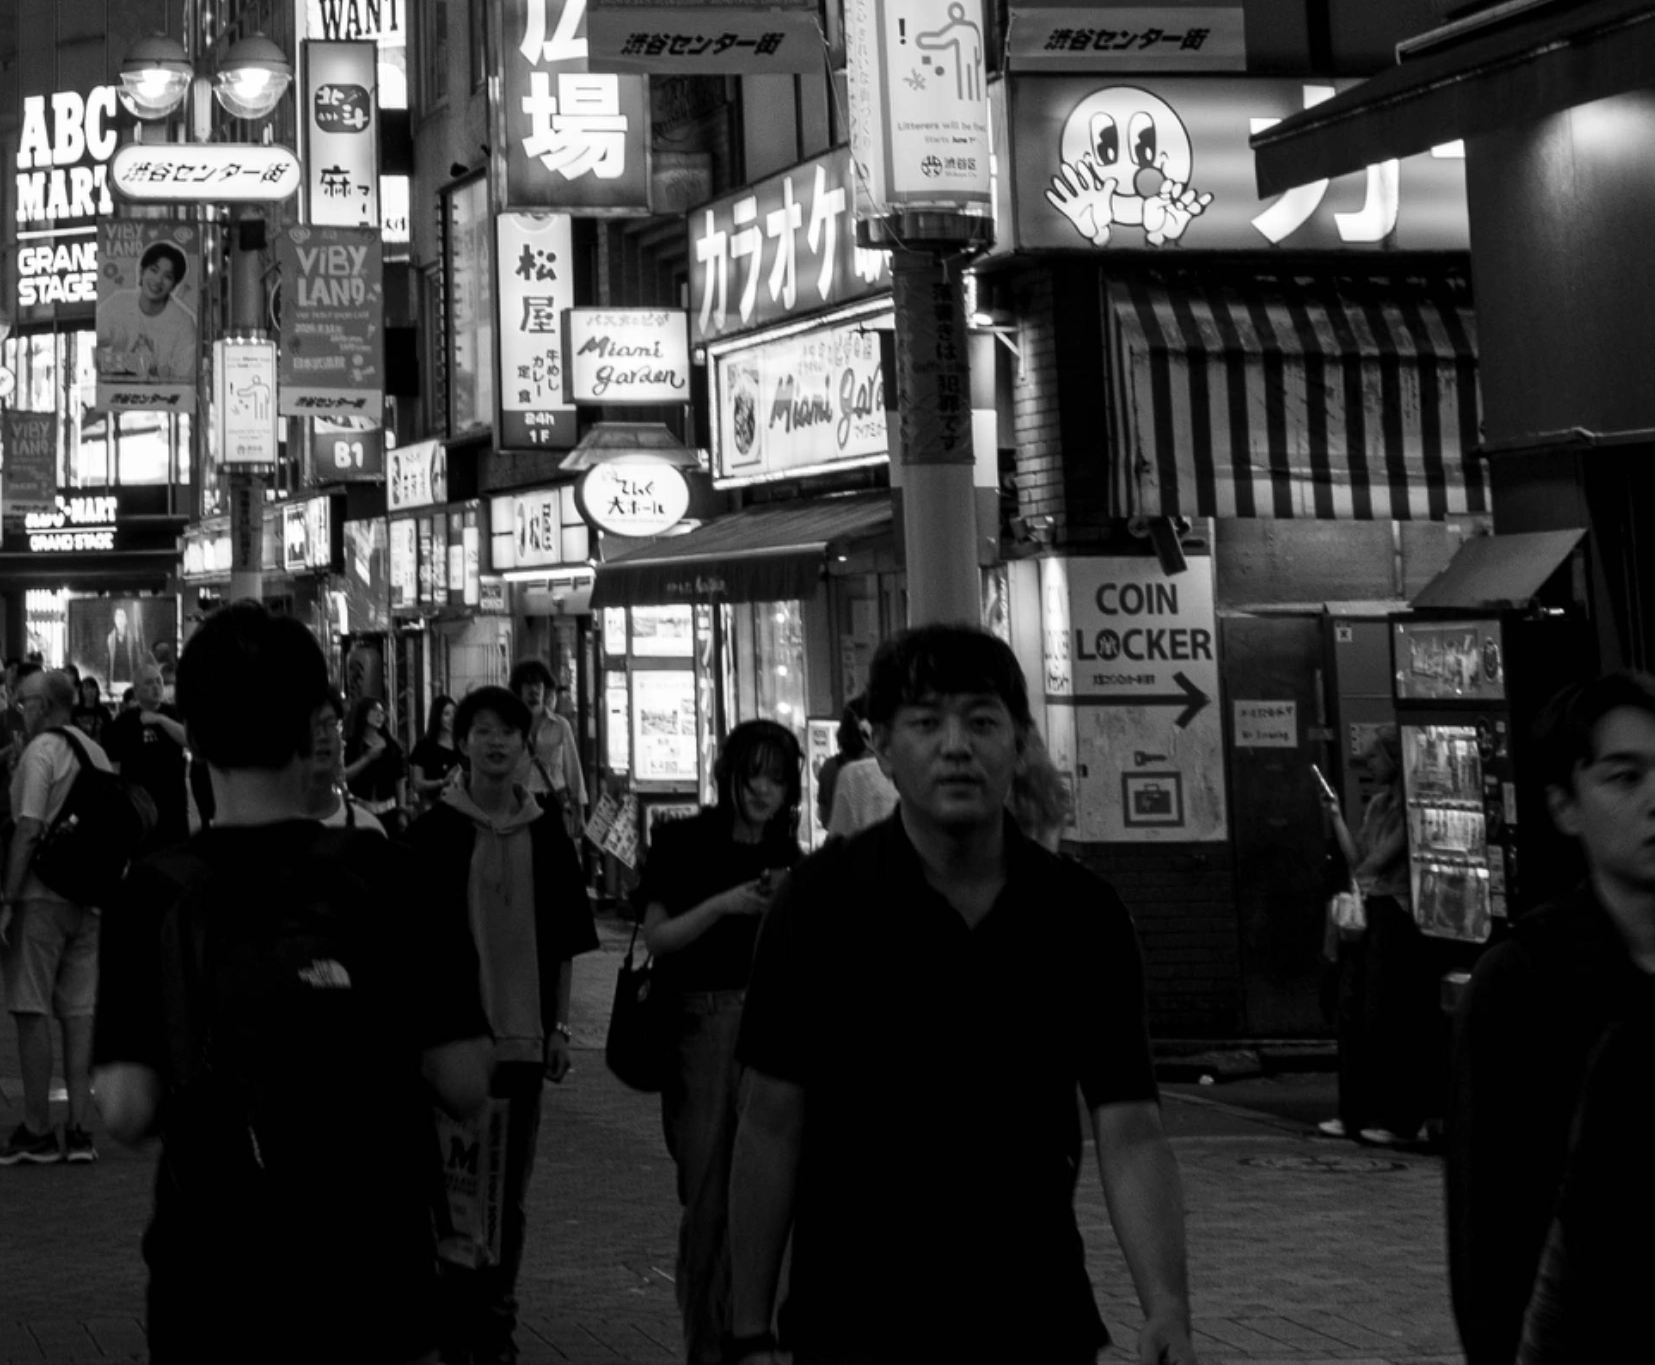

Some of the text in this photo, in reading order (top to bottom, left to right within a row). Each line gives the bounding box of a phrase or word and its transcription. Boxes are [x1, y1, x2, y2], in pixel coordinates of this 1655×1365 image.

[621, 32, 785, 56] 渋谷センター街
[1044, 28, 1211, 52] 渋谷センター街
[17, 85, 119, 170] ABC
[122, 162, 290, 184] 渋谷センター街
[16, 165, 114, 222] MART
[694, 165, 846, 336] カラオケ
[17, 272, 98, 306] STAGE
[297, 277, 365, 307] LAND
[514, 243, 558, 335] 松屋
[576, 335, 665, 359] Miami
[531, 355, 544, 398] カレー
[545, 348, 561, 392] 牛めし
[523, 411, 556, 426] 24h
[769, 373, 834, 433] Miami
[529, 430, 550, 444] 1F
[1095, 582, 1179, 617] COIN
[1075, 627, 1213, 662] LOCKER
